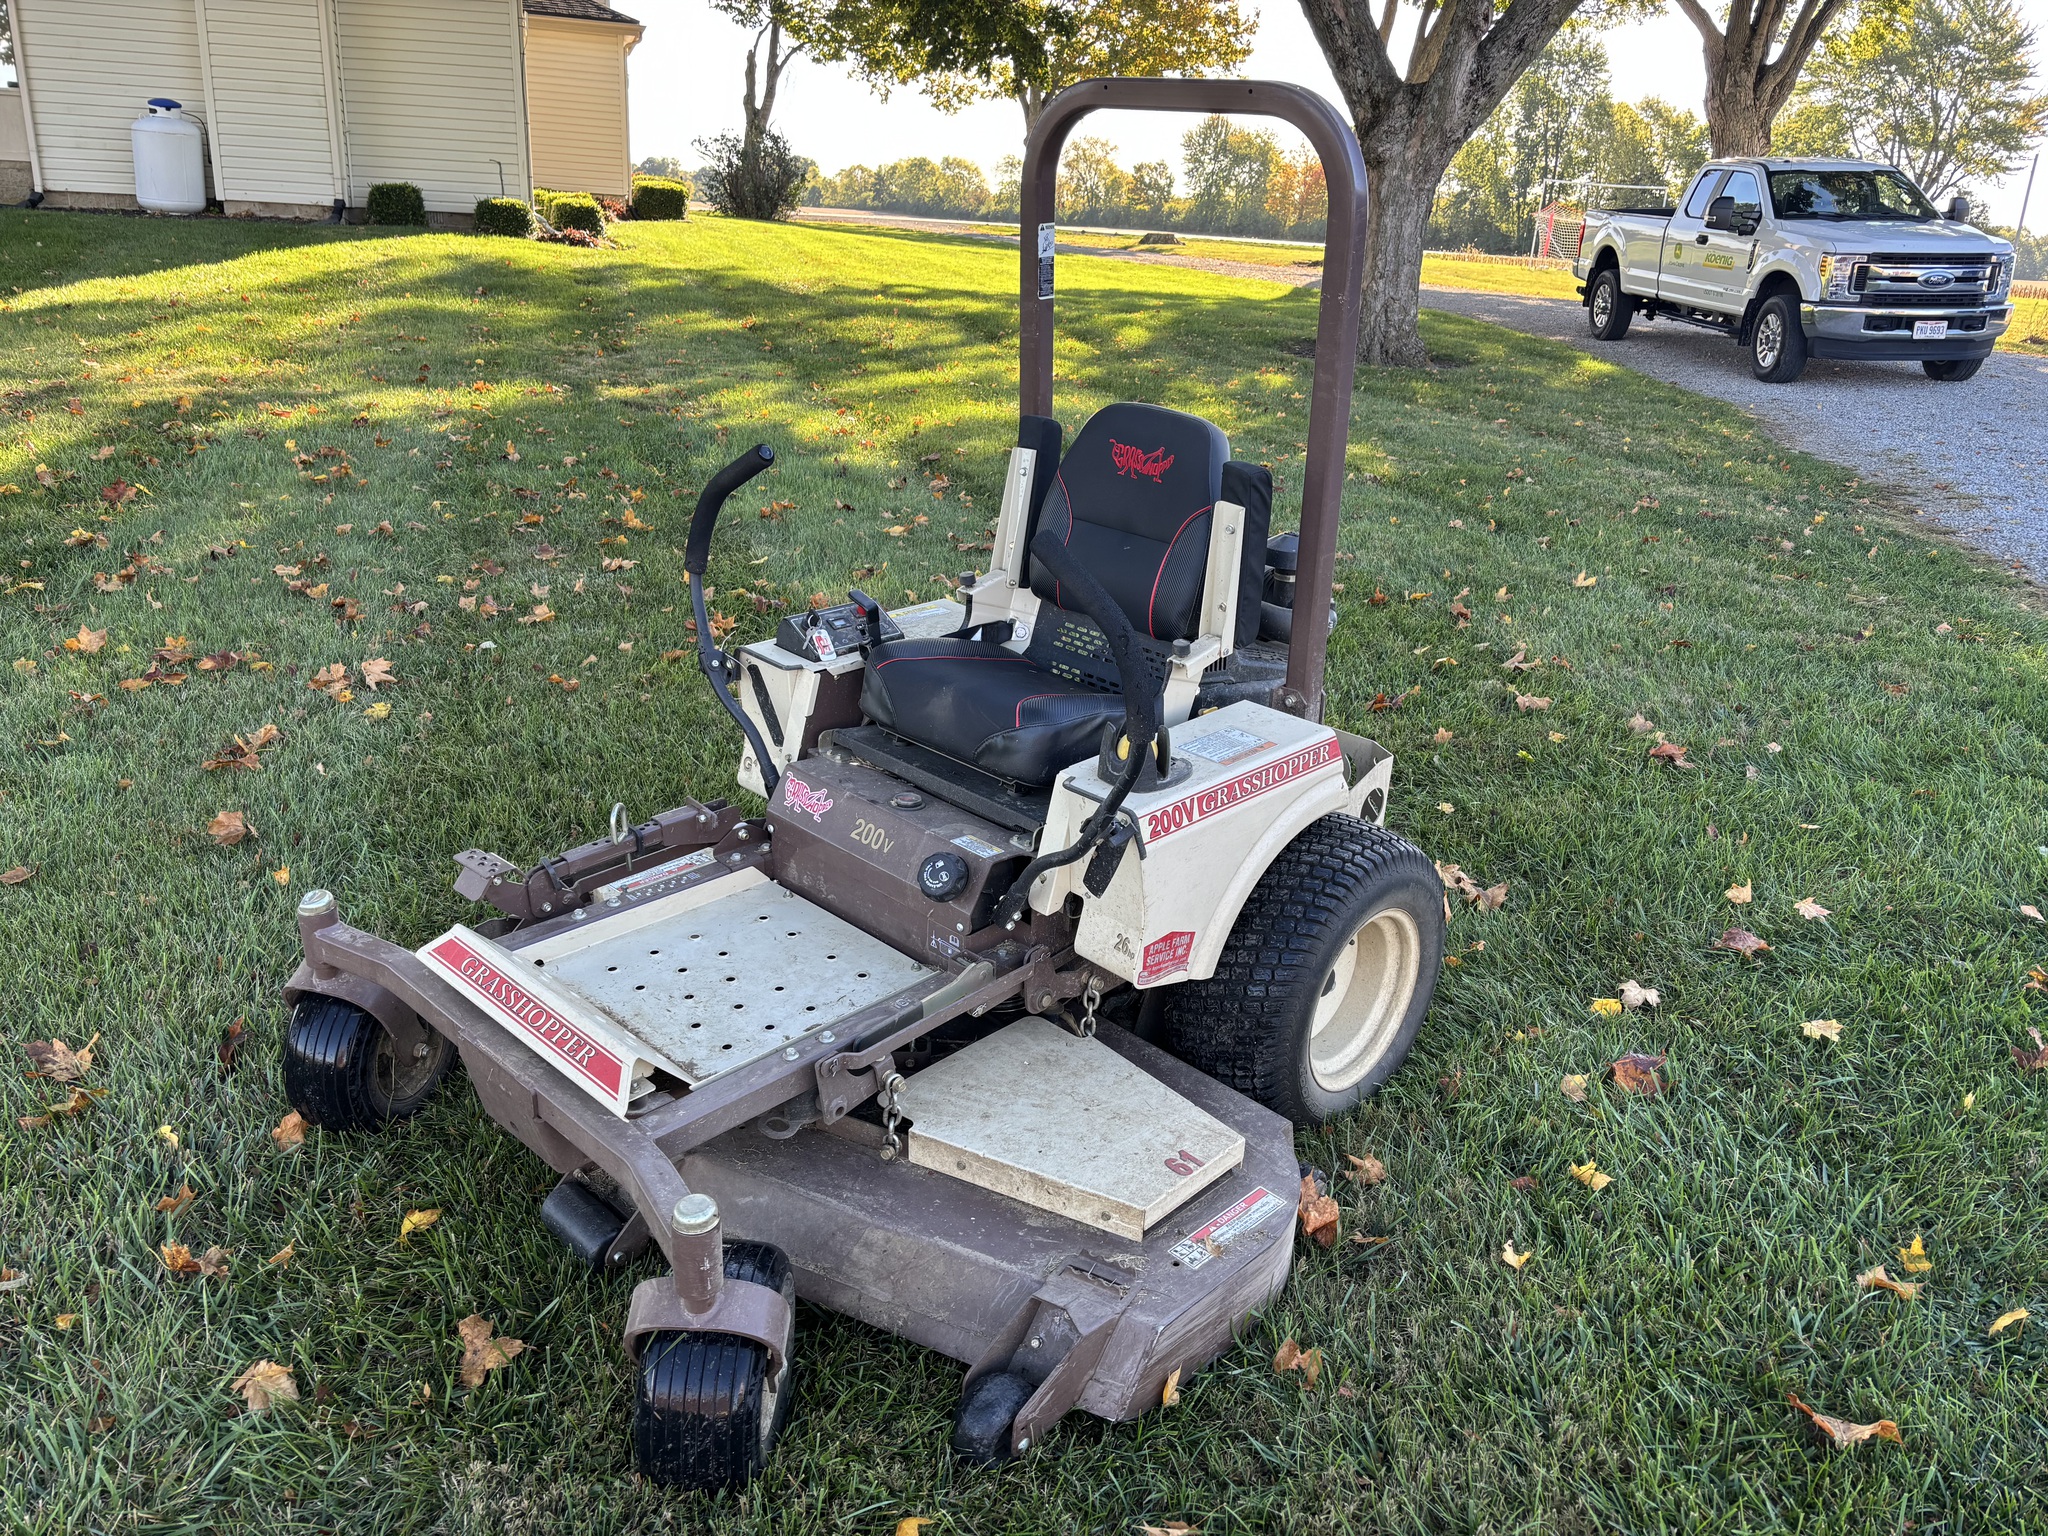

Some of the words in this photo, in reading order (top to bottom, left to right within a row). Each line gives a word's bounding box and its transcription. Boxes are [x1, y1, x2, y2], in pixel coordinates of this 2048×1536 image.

[1928, 275, 1947, 284] Ford
[1916, 325, 1928, 335] PKU
[1929, 325, 1945, 335] 9693
[1148, 797, 1197, 839] 200V
[1202, 744, 1330, 813] GRASSHOPPER
[1146, 949, 1175, 966] SERVICE
[1175, 944, 1189, 958] INC.
[1149, 940, 1170, 955] APPLE
[1171, 933, 1191, 948] FARM
[460, 956, 597, 1068] GRASSHOPPER
[1164, 1149, 1206, 1176] 61
[1217, 1202, 1249, 1225] DANGER
